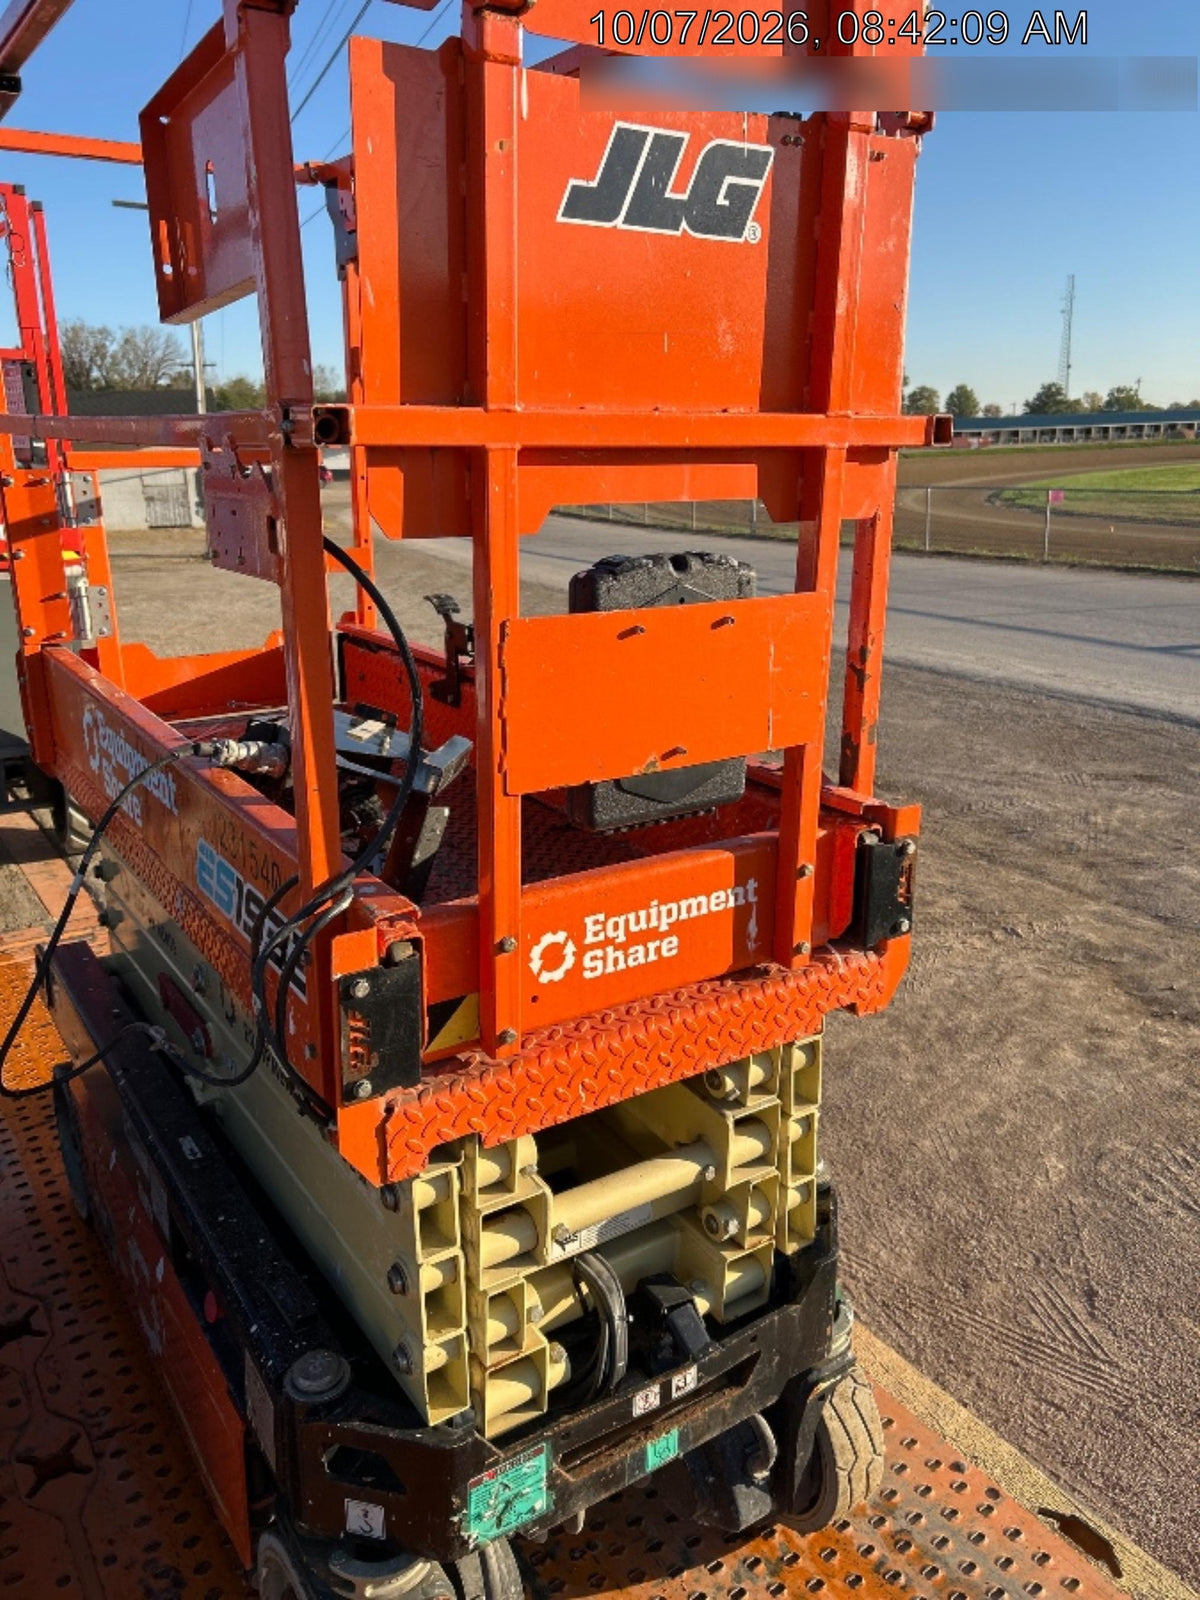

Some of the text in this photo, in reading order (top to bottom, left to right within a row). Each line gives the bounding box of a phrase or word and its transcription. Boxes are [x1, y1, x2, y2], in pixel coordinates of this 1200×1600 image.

[556, 120, 775, 241] JLG
[583, 877, 758, 945] Equipment
[582, 934, 680, 980] Share
